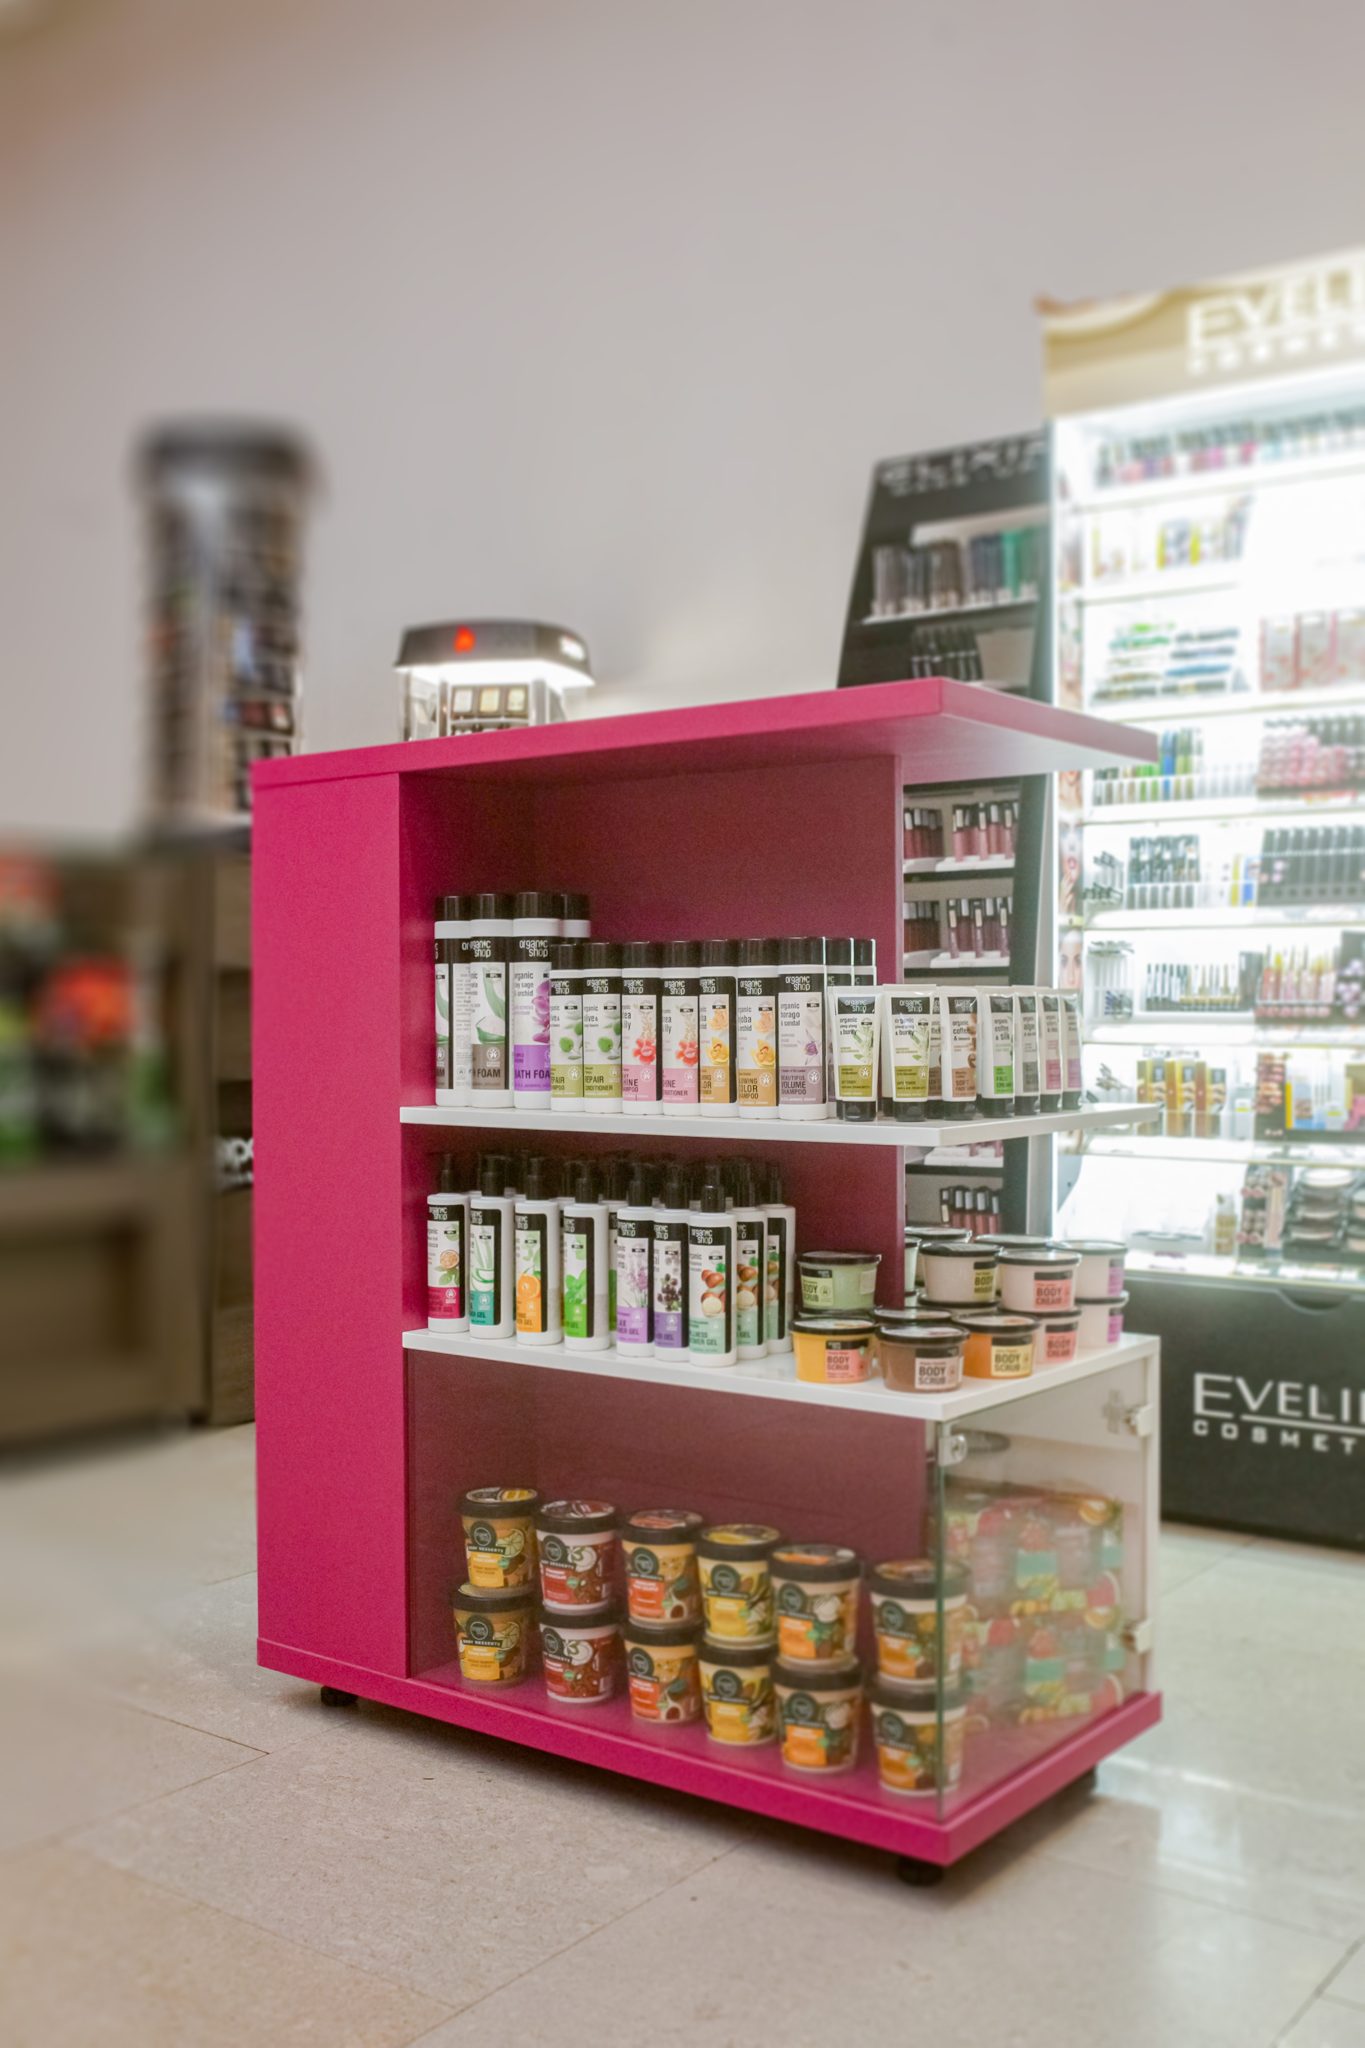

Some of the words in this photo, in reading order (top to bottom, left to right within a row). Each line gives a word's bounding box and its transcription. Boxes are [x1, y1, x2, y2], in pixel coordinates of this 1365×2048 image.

[520, 940, 548, 949] organic
[474, 949, 491, 958] shop
[529, 949, 548, 957] shop
[587, 979, 608, 987] organic
[785, 976, 810, 985] organic
[900, 1000, 922, 1008] organic
[477, 1068, 500, 1078] FOAM
[1037, 1288, 1061, 1296] BODY
[1048, 1340, 1070, 1349] BODY
[995, 1354, 1020, 1363] BODY
[919, 1366, 946, 1376] BODY
[995, 1364, 1020, 1372] SCRUB
[919, 1377, 945, 1385] SCRUB
[1194, 1372, 1365, 1424] EVELI
[1193, 1419, 1357, 1454] COSMET
